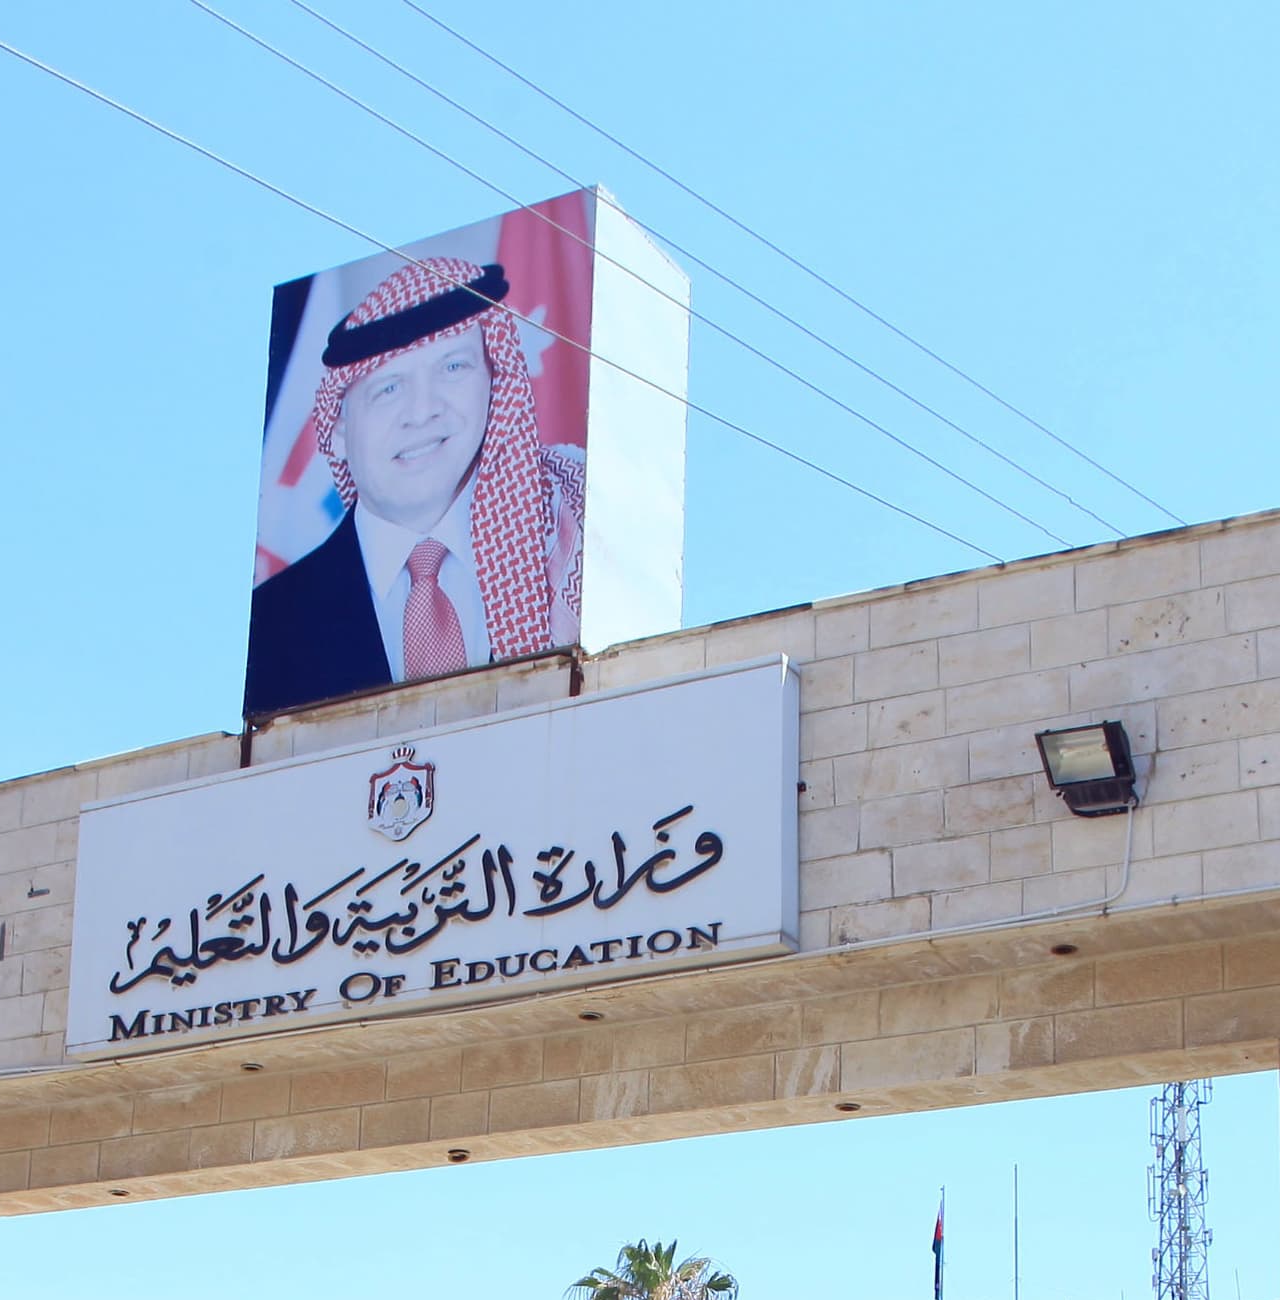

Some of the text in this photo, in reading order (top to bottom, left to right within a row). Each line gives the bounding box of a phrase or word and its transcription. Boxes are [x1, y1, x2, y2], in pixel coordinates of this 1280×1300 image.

[107, 922, 723, 1042] MINISTRY OF EDUCATION
